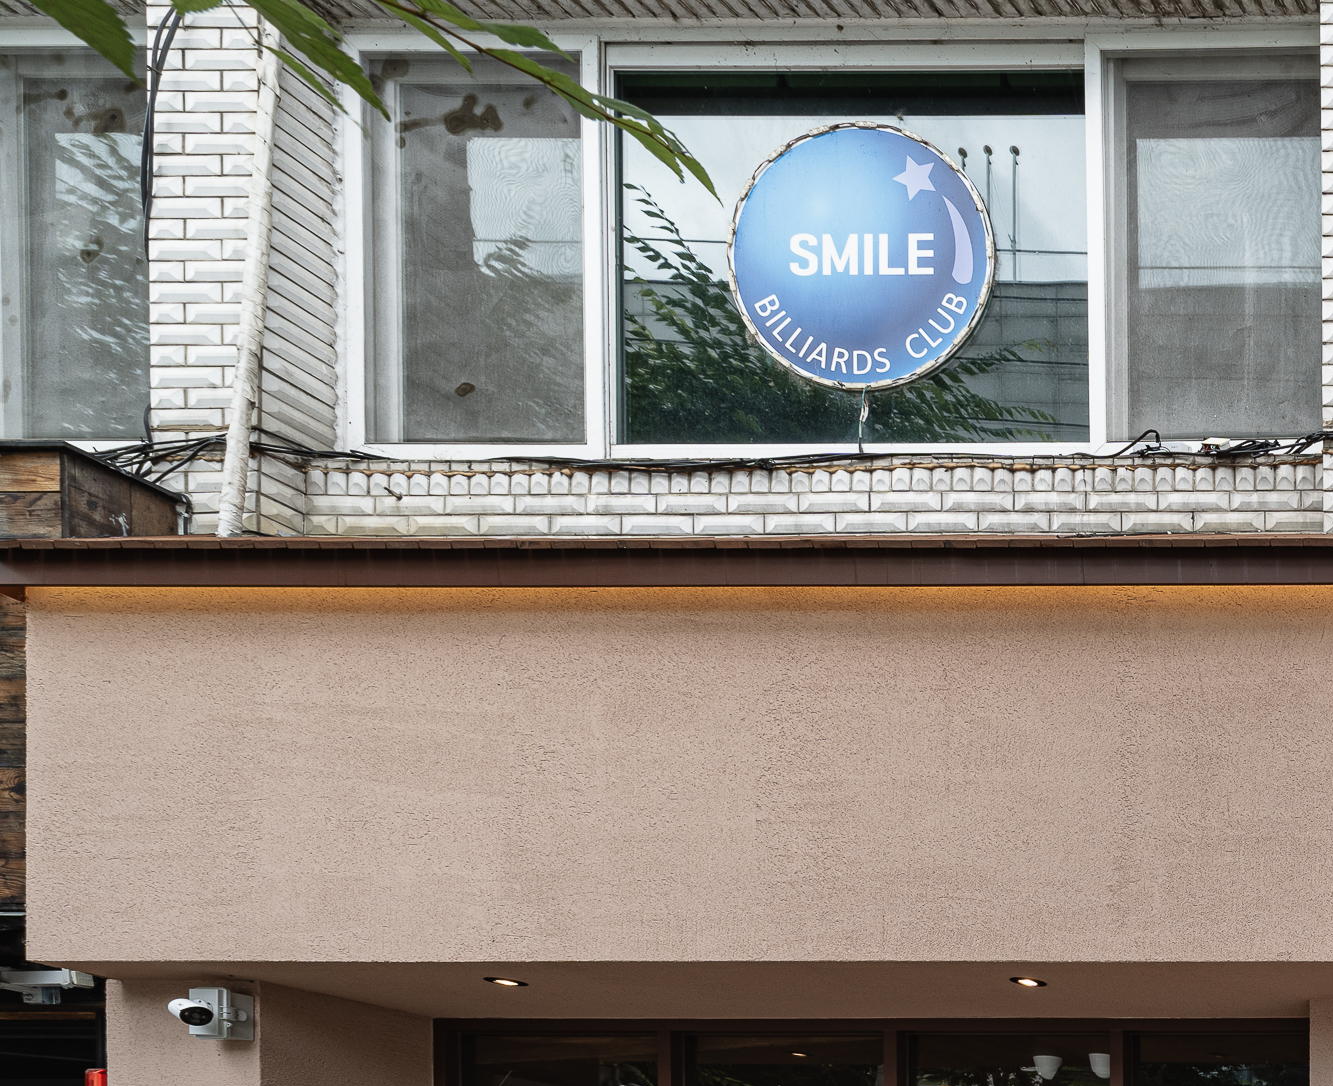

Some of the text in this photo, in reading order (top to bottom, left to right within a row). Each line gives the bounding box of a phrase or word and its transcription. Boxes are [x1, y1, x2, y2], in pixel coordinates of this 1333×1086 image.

[789, 232, 935, 276] SMILE
[754, 291, 968, 375] BILLIARDS CLUB
